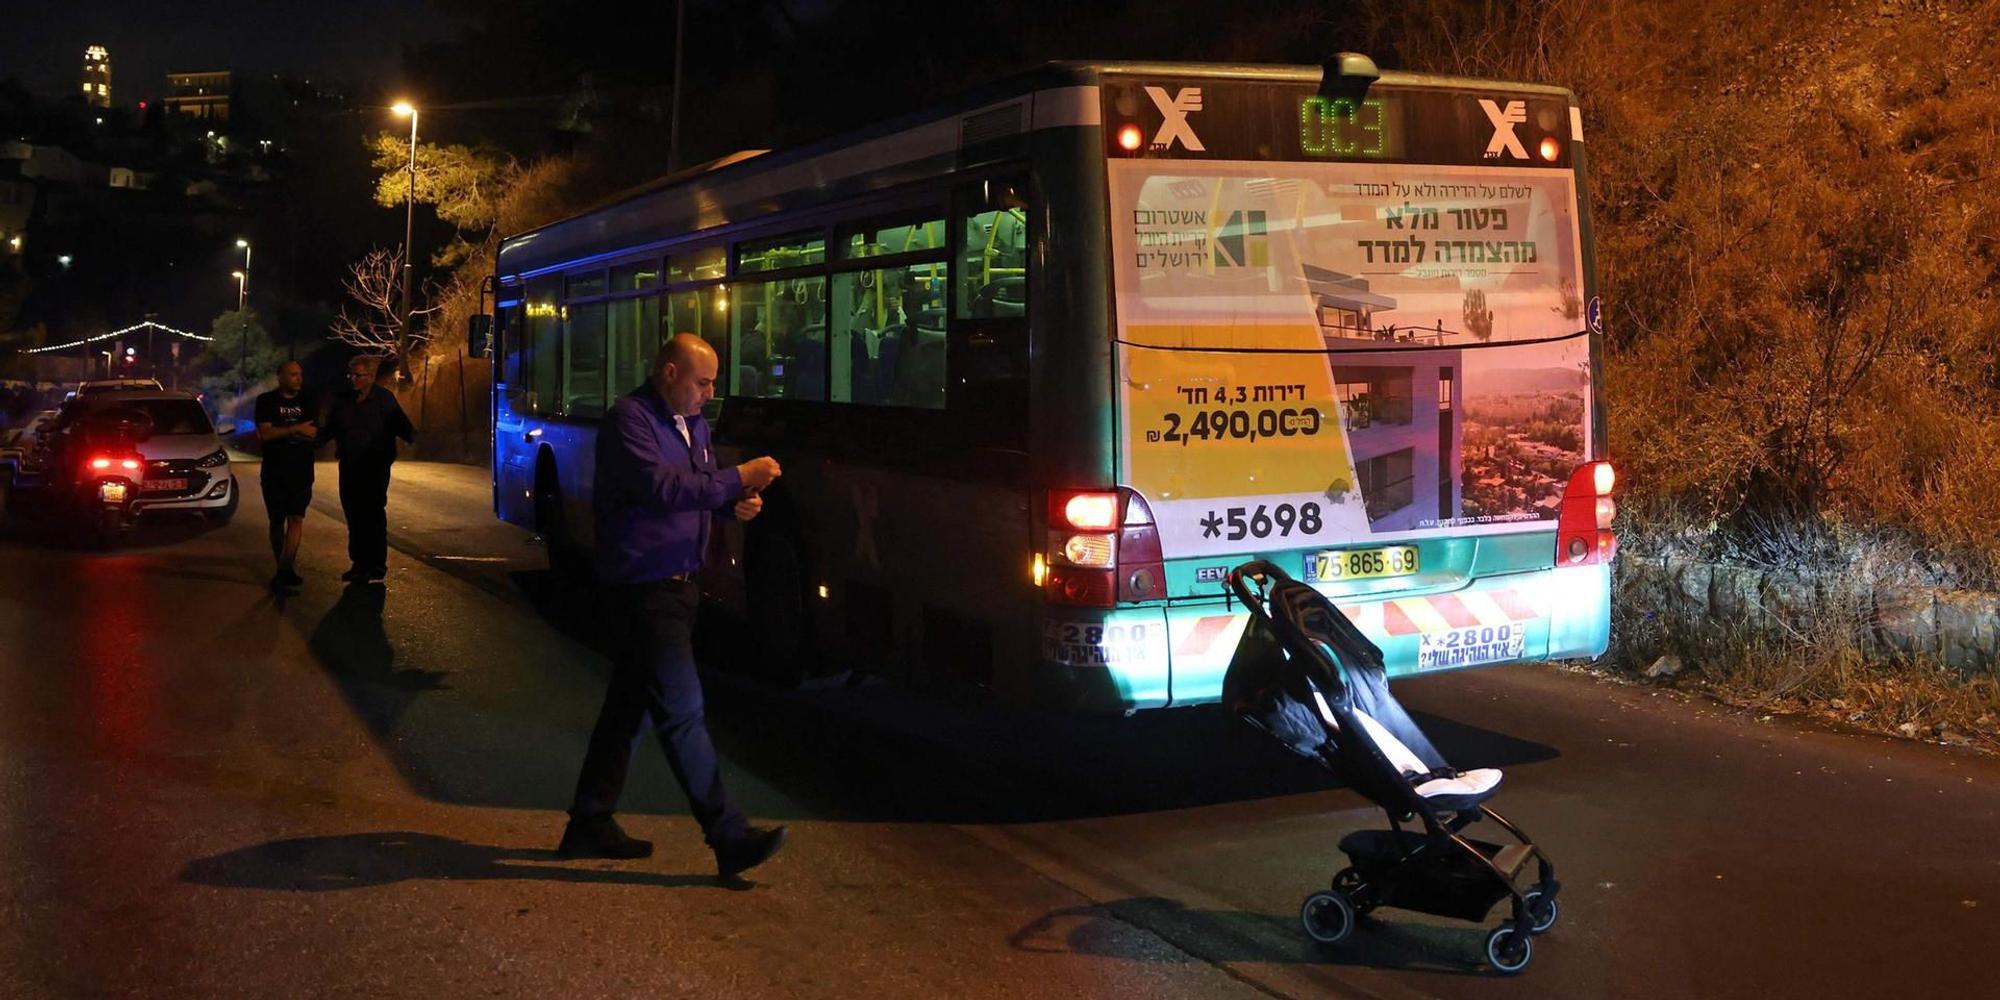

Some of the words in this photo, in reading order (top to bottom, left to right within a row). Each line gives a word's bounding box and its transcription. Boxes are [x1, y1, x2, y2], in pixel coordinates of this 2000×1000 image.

[1354, 183, 1390, 197] המדד
[1392, 181, 1411, 198] על
[1414, 182, 1436, 198] ולא
[1440, 184, 1476, 198] הדירה
[1481, 183, 1496, 199] על
[1499, 185, 1532, 199] לשלם
[1133, 210, 1206, 225] אשטרום
[1386, 201, 1440, 230] מלא
[1446, 208, 1508, 231] פטור
[1358, 234, 1426, 264] למדד
[1435, 240, 1537, 264] מהצמדה
[1136, 249, 1209, 268] ירושלים
[1214, 386, 1247, 406] 4,3
[1252, 384, 1305, 402] דירות
[1197, 568, 1227, 581] EEV
[1452, 644, 1489, 664] הנהיגה
[1491, 641, 1510, 660] איך
